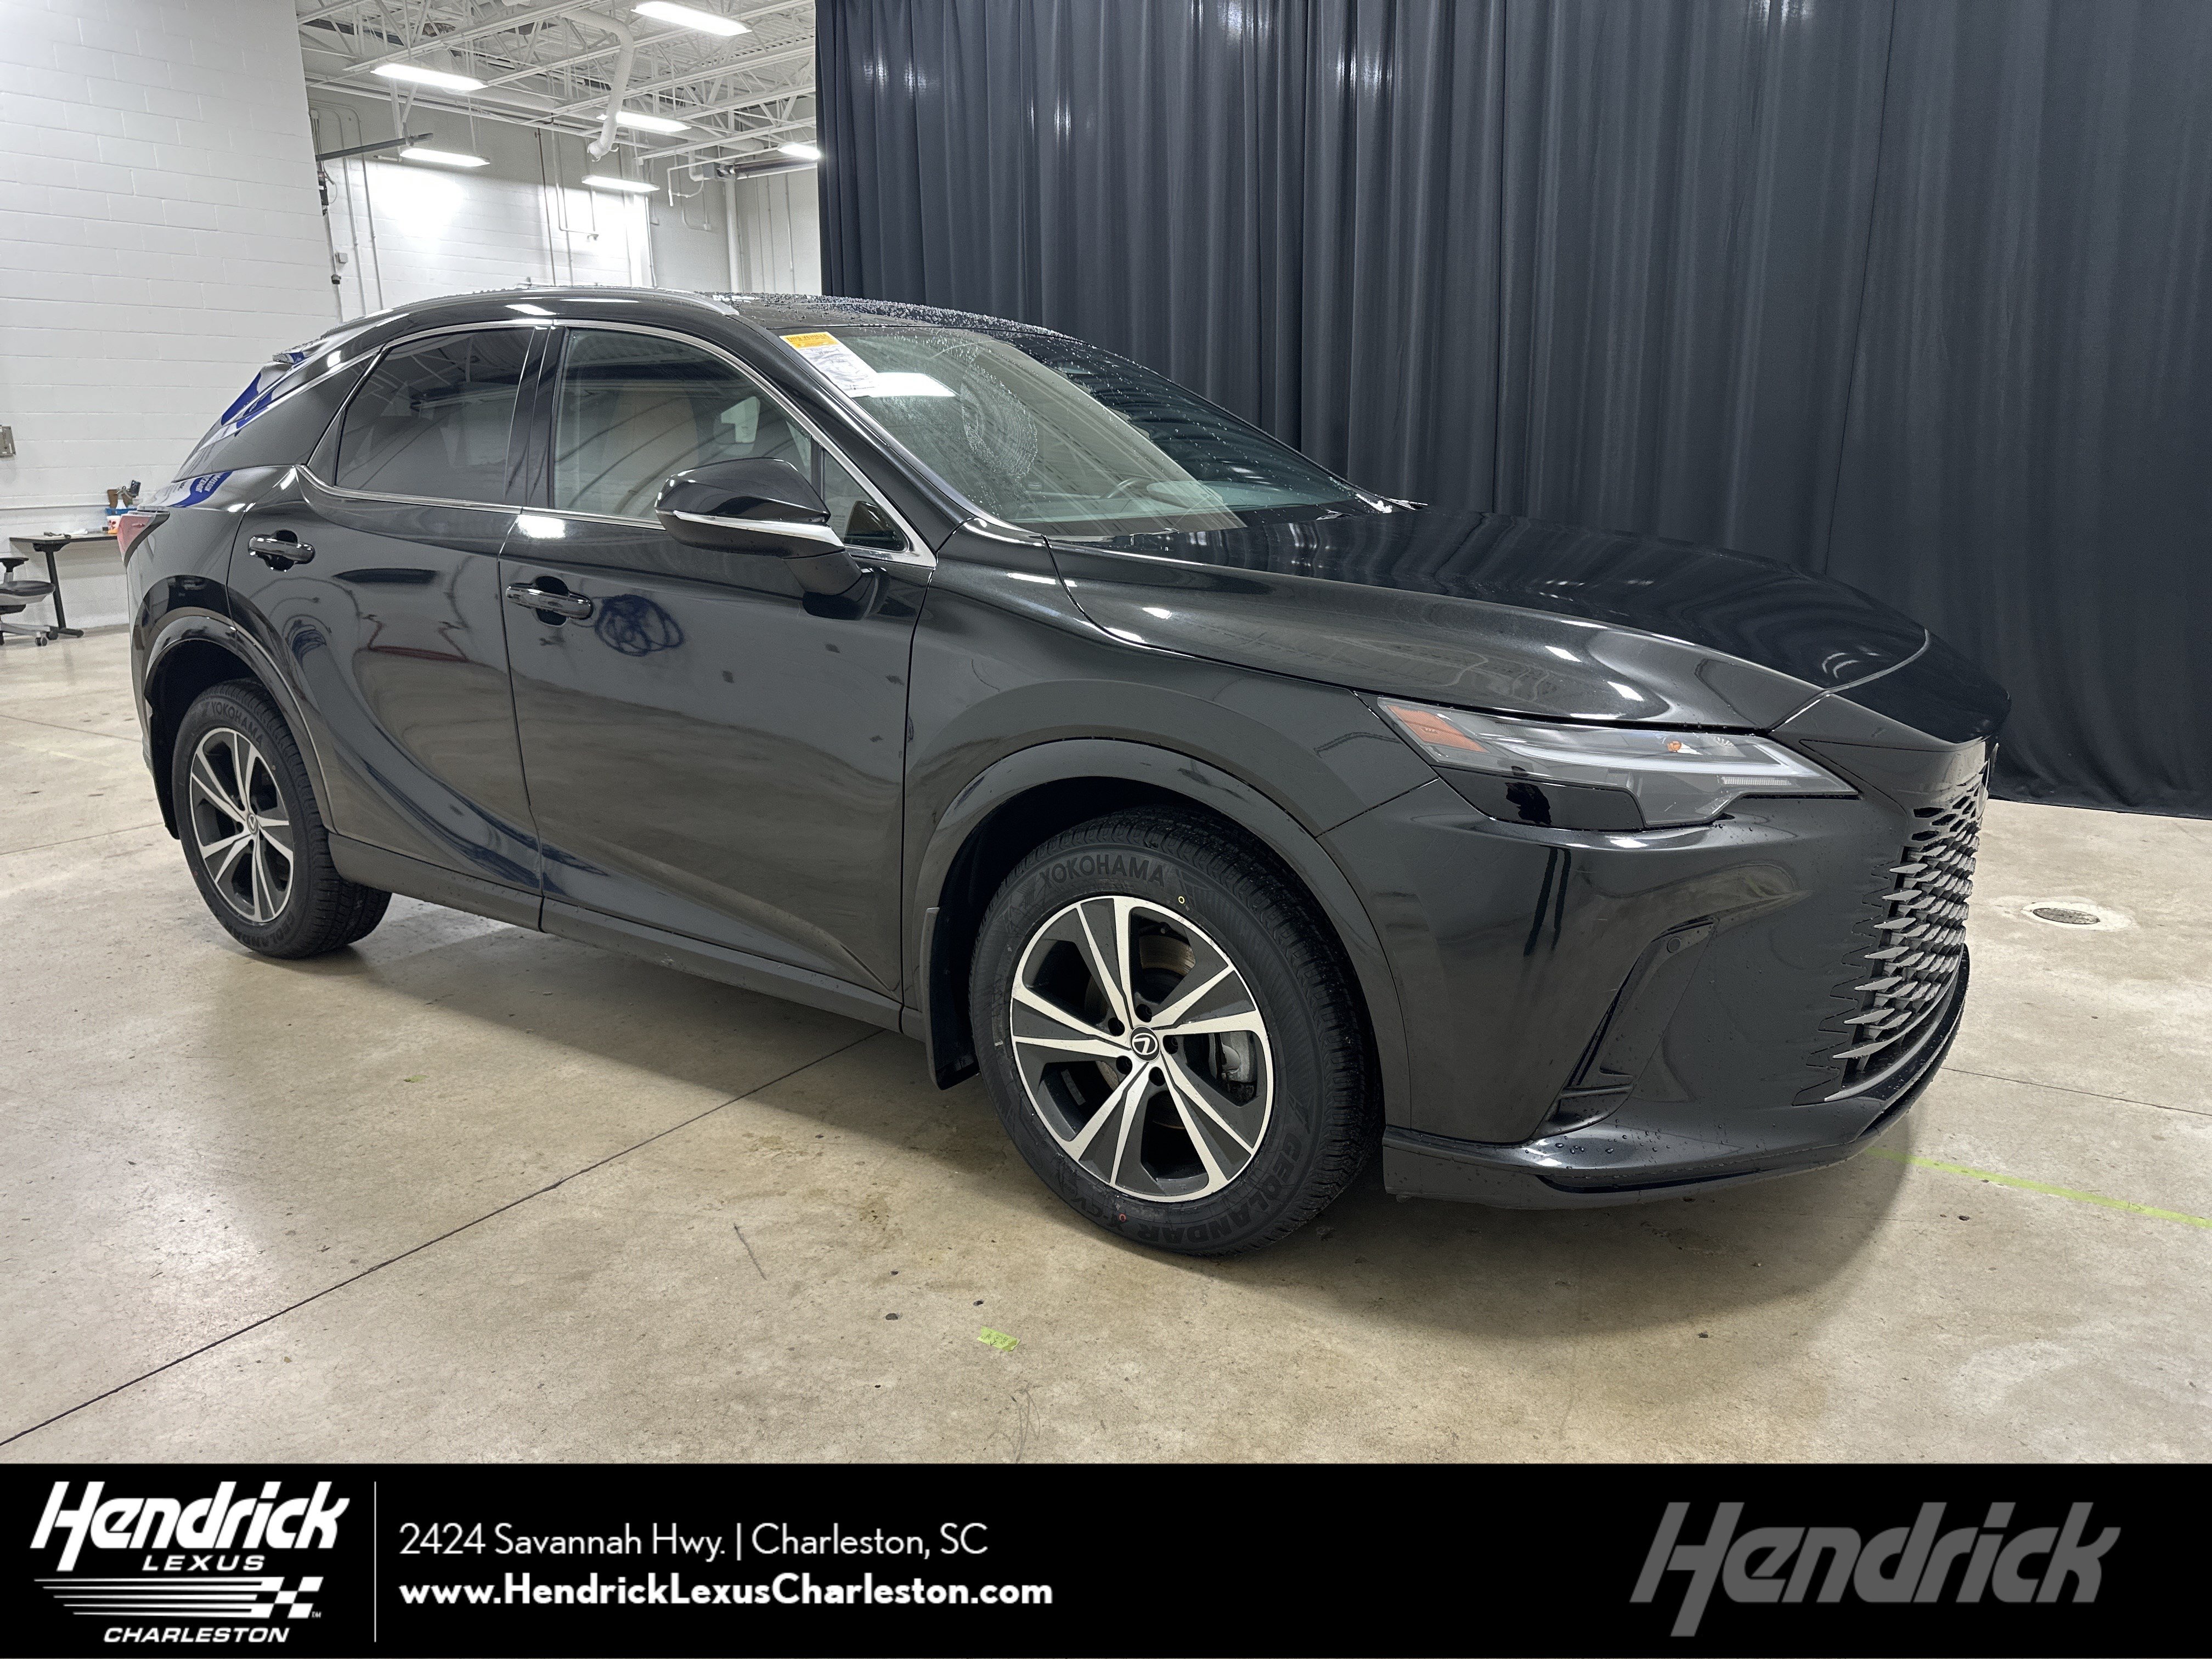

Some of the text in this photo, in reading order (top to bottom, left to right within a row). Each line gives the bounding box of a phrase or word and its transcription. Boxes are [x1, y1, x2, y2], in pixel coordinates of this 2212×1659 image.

[211, 702, 262, 746] YOKOHAMA
[1040, 854, 1165, 889] YOKOHAMA
[1137, 1133, 1302, 1243] GEOLANDAR
